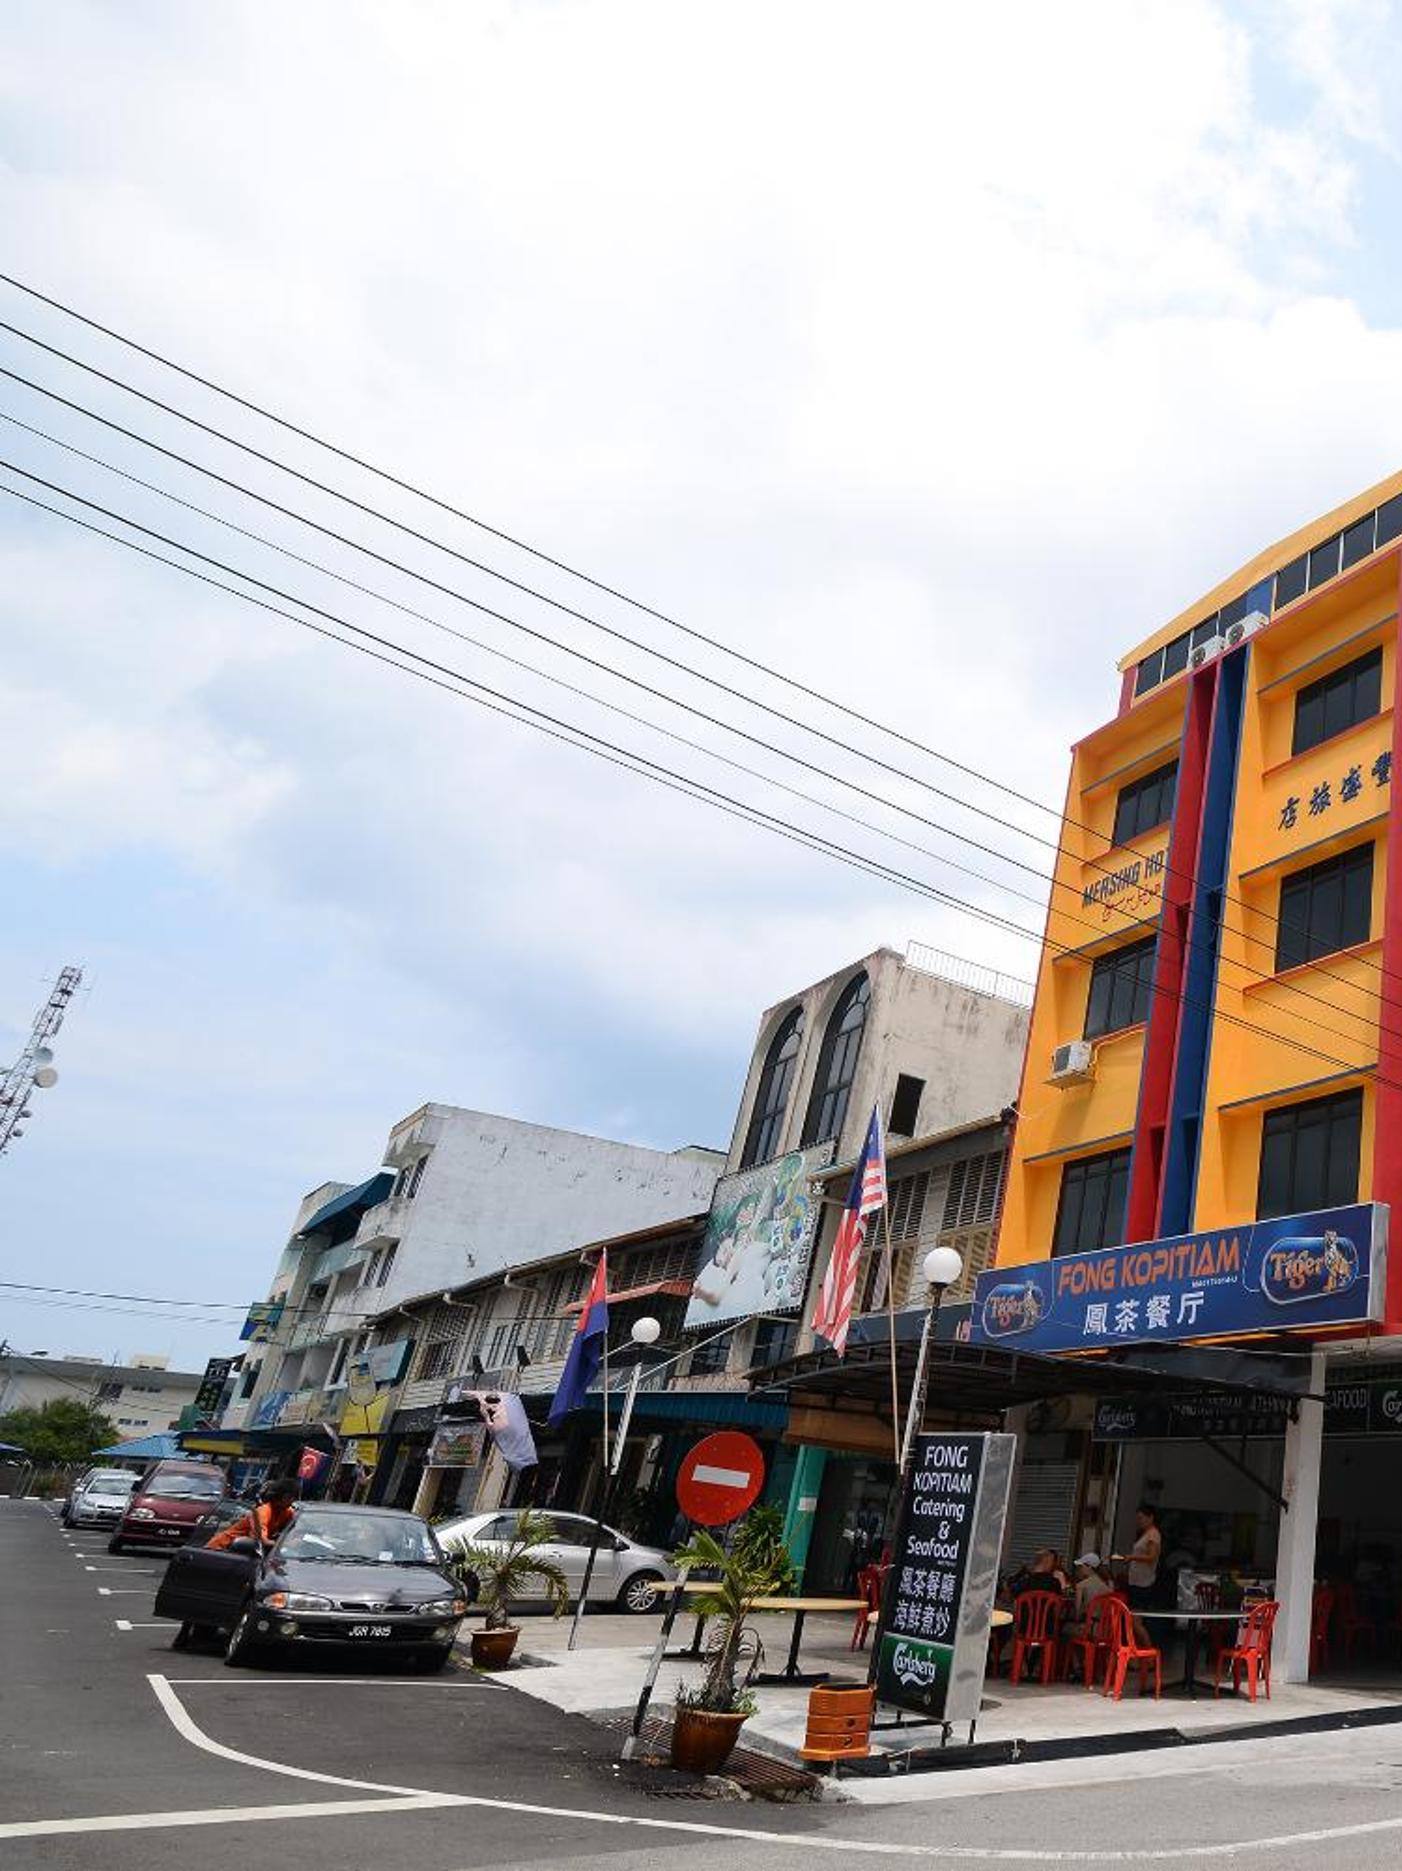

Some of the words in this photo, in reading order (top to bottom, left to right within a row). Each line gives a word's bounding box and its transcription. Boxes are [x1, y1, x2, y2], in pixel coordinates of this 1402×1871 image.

[1081, 860, 1141, 909] MERSING
[1057, 1257, 1117, 1298] FONG
[1121, 1236, 1241, 1289] KOPITIAM
[1270, 1249, 1325, 1291] Tiger
[924, 1445, 969, 1468] FONG
[912, 1472, 973, 1494] KOPITIAM
[913, 1496, 966, 1523] Catering
[938, 1520, 951, 1540] &
[906, 1535, 960, 1560] Seafood
[892, 1642, 937, 1684] Carlsberg
